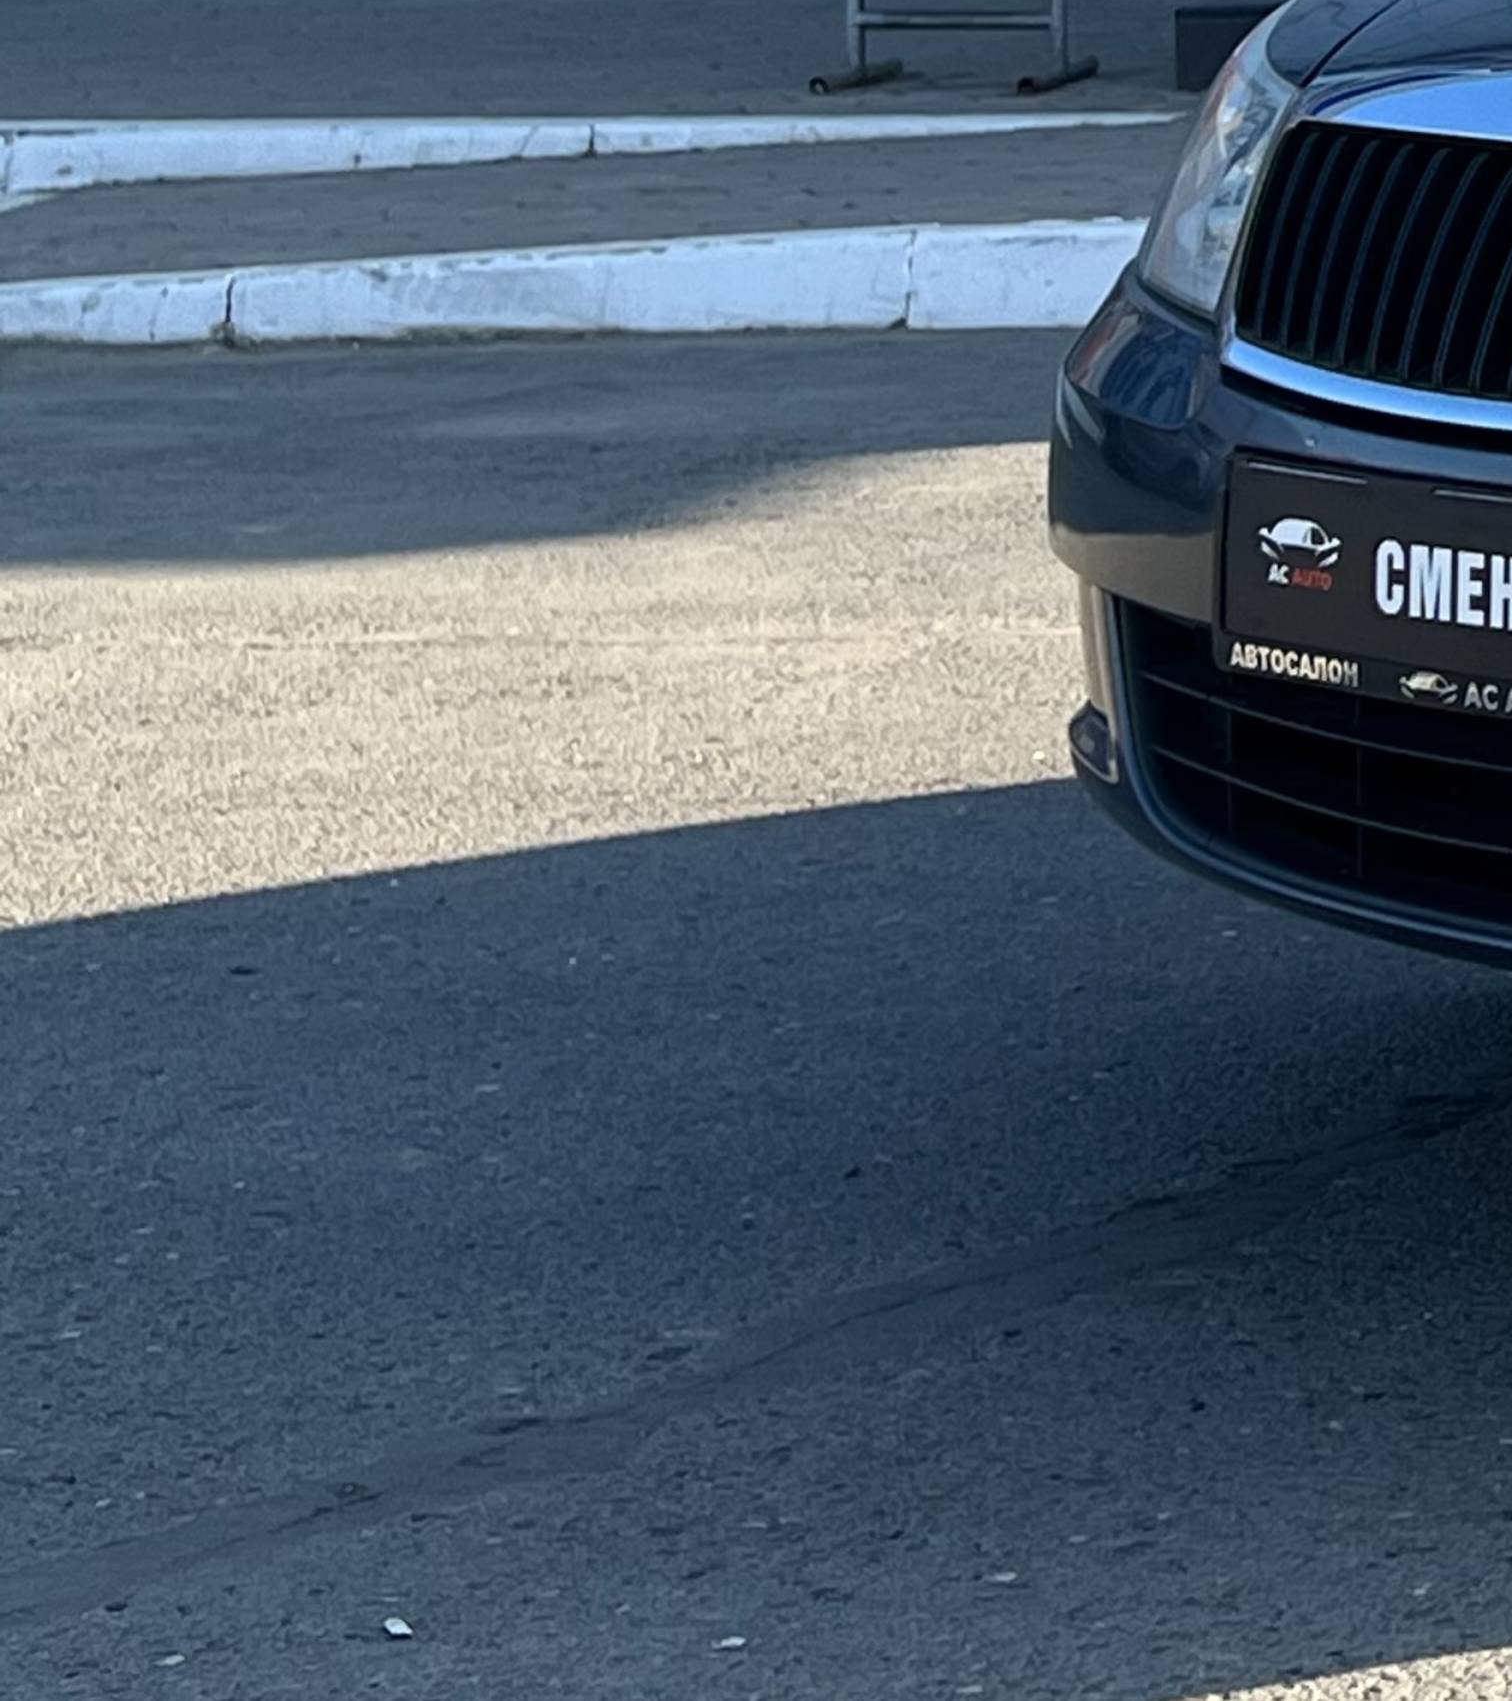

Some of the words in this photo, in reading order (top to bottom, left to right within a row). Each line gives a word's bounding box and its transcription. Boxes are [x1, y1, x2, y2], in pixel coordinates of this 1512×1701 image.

[1266, 562, 1290, 586] AC
[1292, 567, 1334, 592] AUTO
[1229, 642, 1360, 688] АВТОСАЛОН
[1464, 680, 1499, 712] AC
